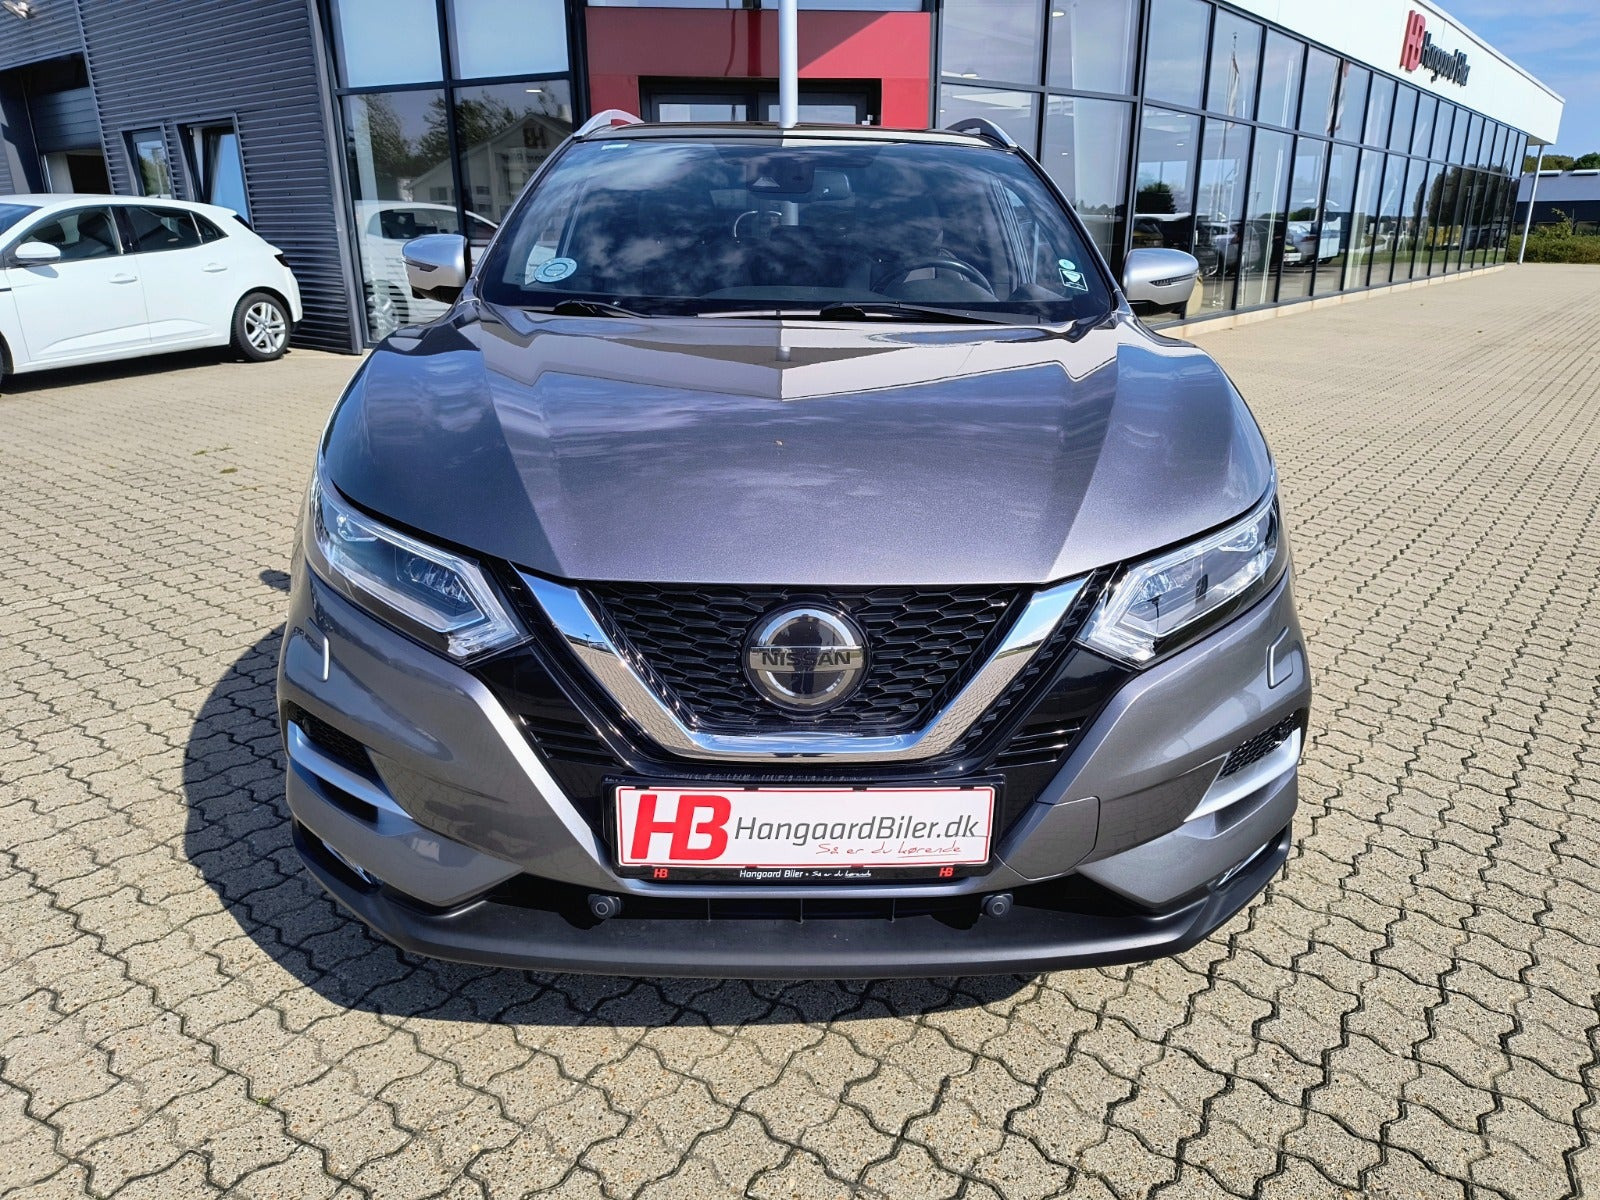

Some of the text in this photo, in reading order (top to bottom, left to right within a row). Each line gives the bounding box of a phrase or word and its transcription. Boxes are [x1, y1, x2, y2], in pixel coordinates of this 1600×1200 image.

[1400, 10, 1426, 71] HB
[762, 652, 851, 666] NISSAN
[630, 794, 731, 860] HB
[734, 815, 979, 846] HangaardBiler.dk
[816, 843, 839, 855] Så
[872, 841, 892, 854] du
[653, 868, 669, 879] HB
[740, 870, 781, 879] Hangaard
[784, 870, 803, 878] Biler
[939, 867, 954, 878] HB
